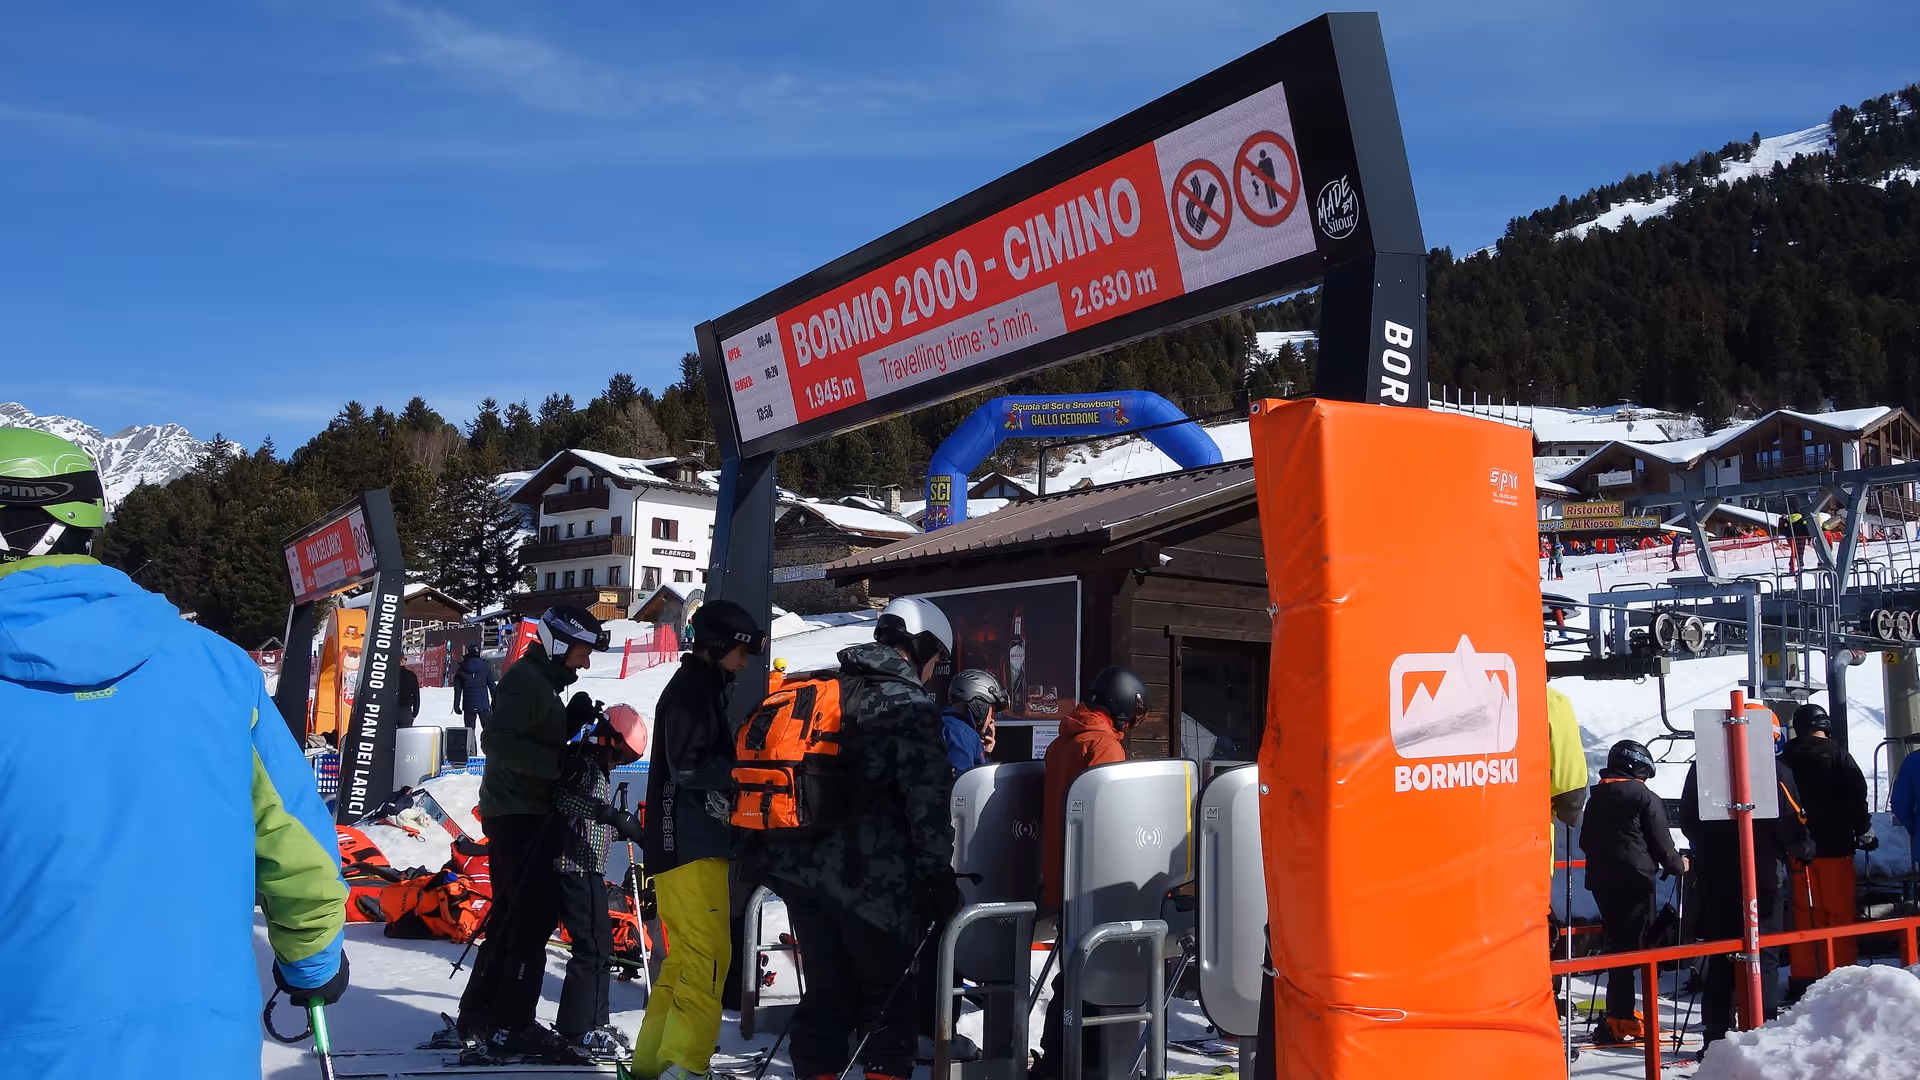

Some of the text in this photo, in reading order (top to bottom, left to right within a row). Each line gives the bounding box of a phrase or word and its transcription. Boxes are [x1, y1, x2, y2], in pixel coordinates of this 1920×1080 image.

[1318, 174, 1350, 226] MADE
[1327, 214, 1353, 234] sitour
[791, 177, 1141, 367] BORMIO 2000 - CIMINO
[1070, 266, 1158, 318] 2.630 m
[879, 307, 1038, 383] Travelling time: 5 min.
[1380, 319, 1413, 406] BOR
[805, 376, 857, 410] 1.945 m
[1012, 403, 1040, 411] Scuola
[1042, 402, 1050, 410] di
[1051, 402, 1065, 410] Sci
[1072, 399, 1120, 409] Snowboard
[1031, 411, 1100, 426] GALLO CEDRONE
[930, 482, 951, 501] SCI
[1566, 503, 1621, 515] Ristorante
[1571, 519, 1581, 529] Al
[1583, 518, 1614, 529] Kiosco
[659, 549, 691, 558] ALBERGO
[375, 593, 398, 649] BORMIO
[369, 651, 389, 690] 2000
[1767, 654, 1773, 664] 1
[1886, 653, 1895, 663] 2
[360, 703, 381, 738] PIAN
[357, 742, 375, 766] DEI
[1394, 758, 1518, 792] BORMIOSKI
[348, 769, 370, 816] LARICI
